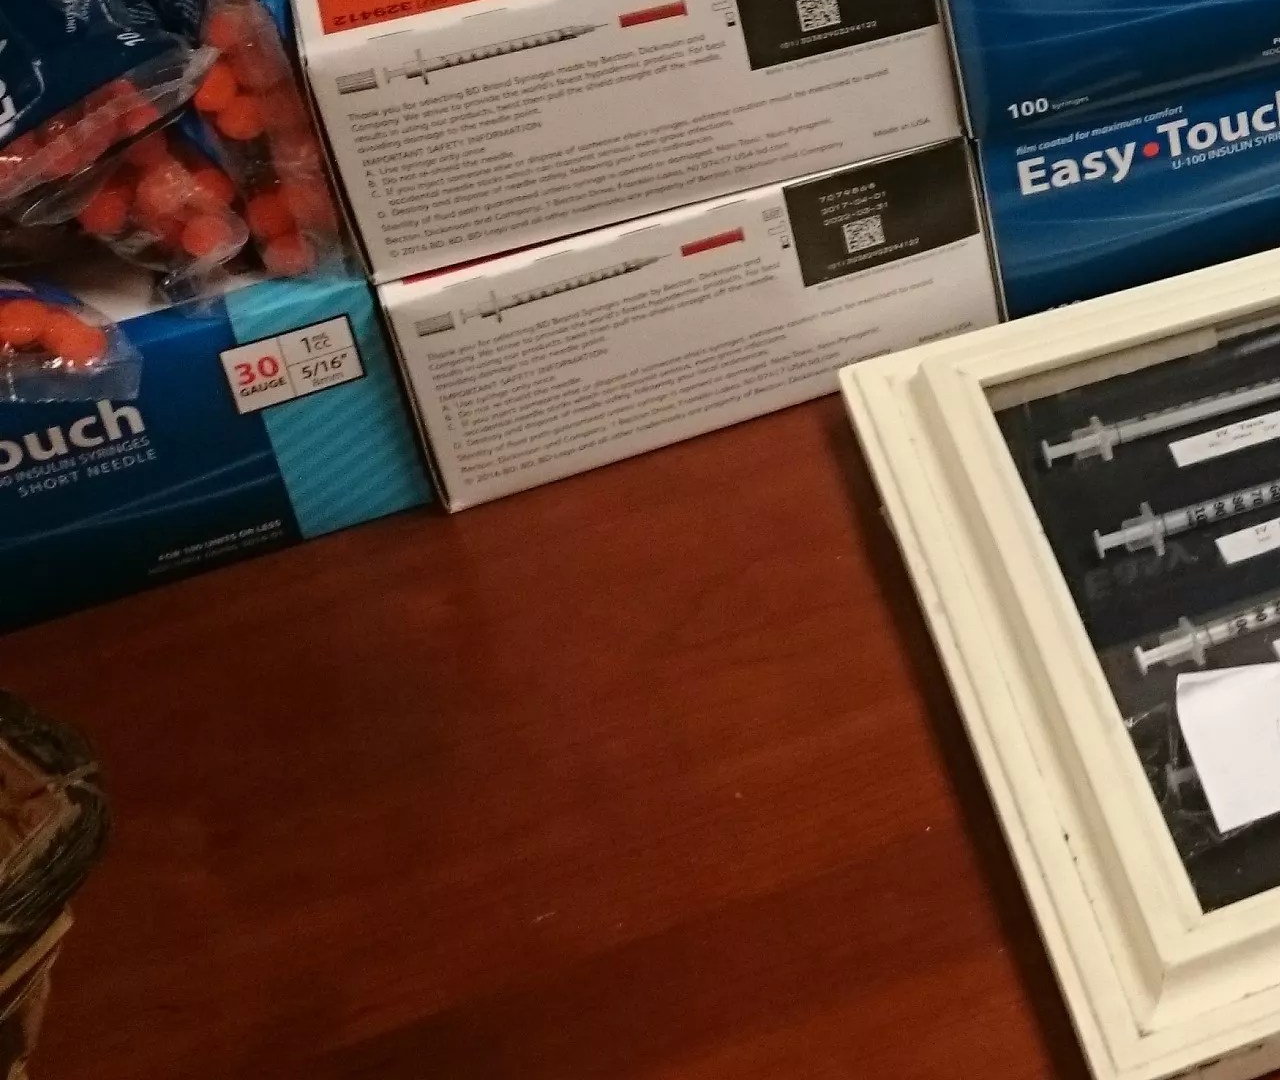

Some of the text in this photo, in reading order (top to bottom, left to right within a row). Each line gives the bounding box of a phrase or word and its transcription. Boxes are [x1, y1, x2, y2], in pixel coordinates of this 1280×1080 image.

[1007, 96, 1050, 119] 100
[233, 354, 281, 387] 30
[240, 376, 287, 398] GAUGE
[18, 447, 158, 499] SHORT NEEDLE
